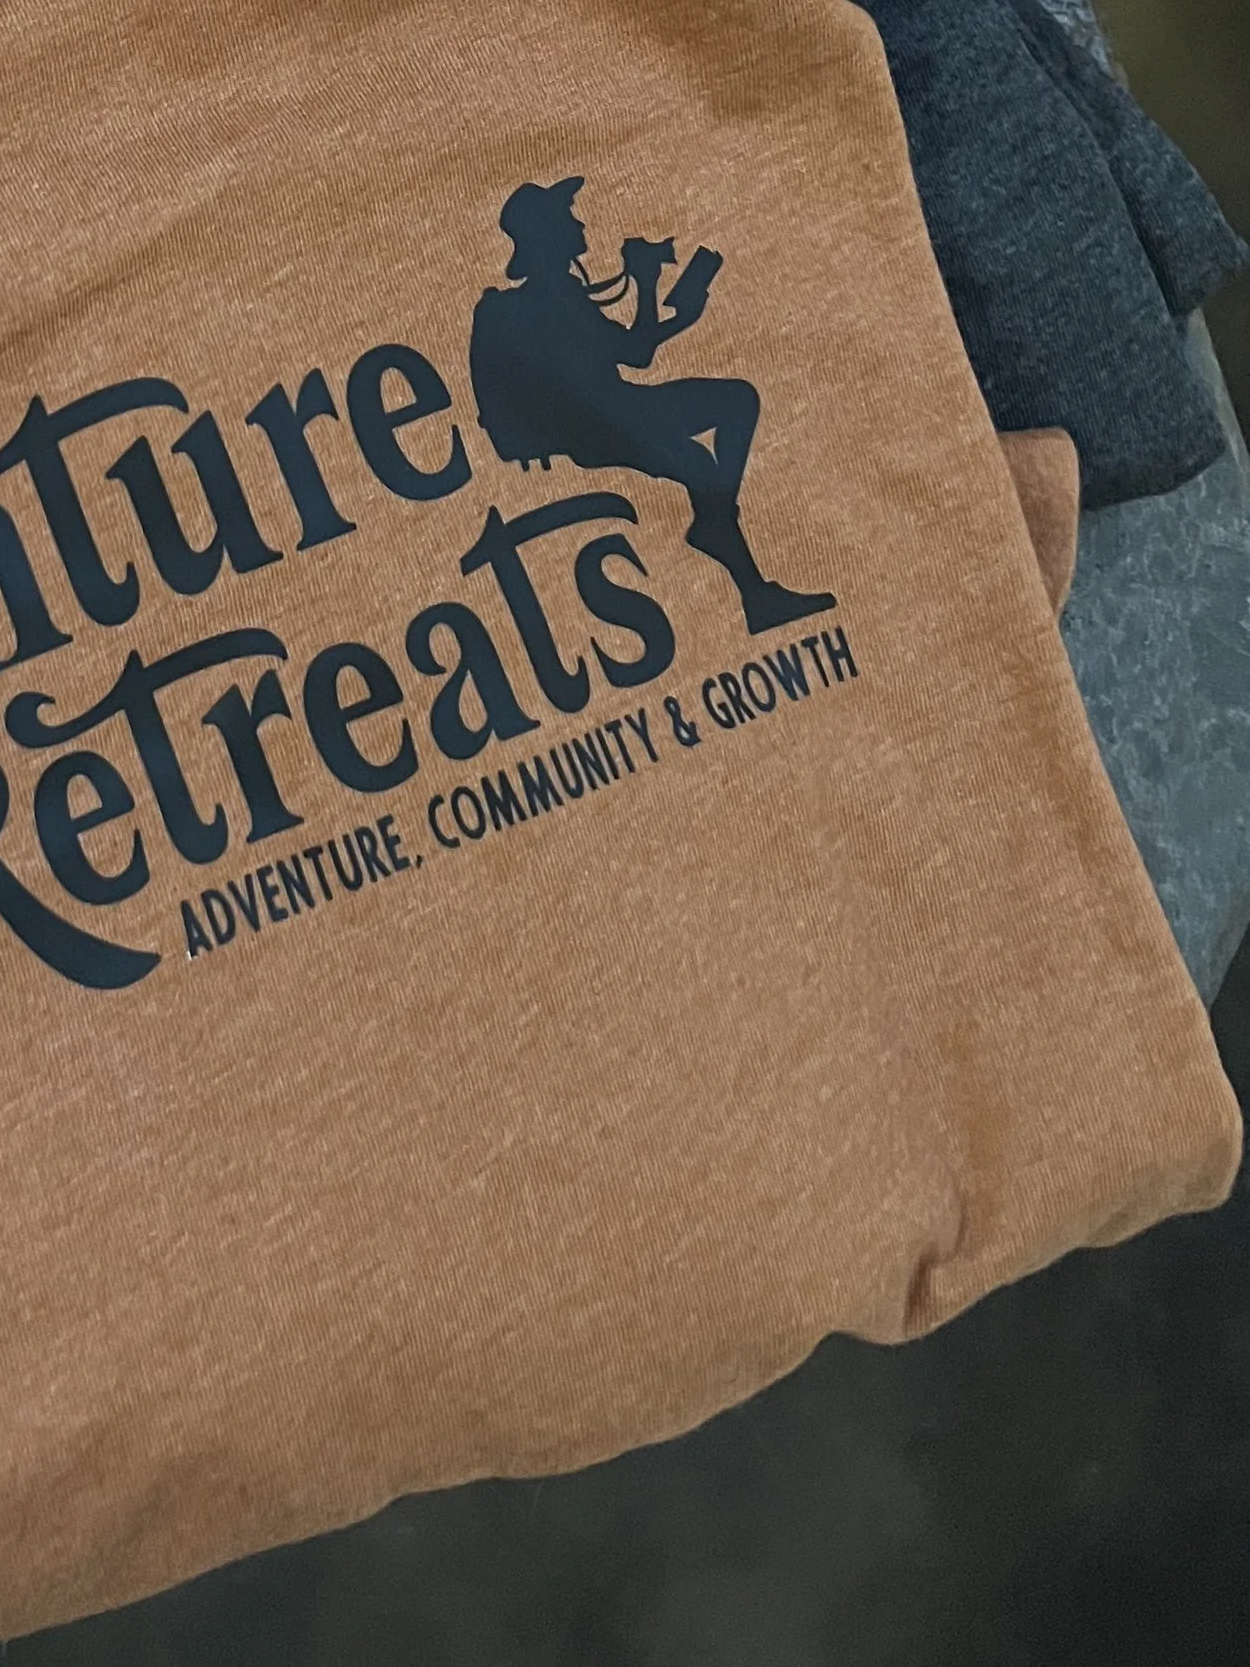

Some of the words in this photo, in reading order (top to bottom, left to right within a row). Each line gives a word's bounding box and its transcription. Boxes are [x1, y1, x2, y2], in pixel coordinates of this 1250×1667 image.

[178, 814, 425, 960] ADVENTURE,
[427, 707, 660, 848] COMMUNITY
[663, 694, 701, 747] &
[702, 626, 859, 728] GROWTH
